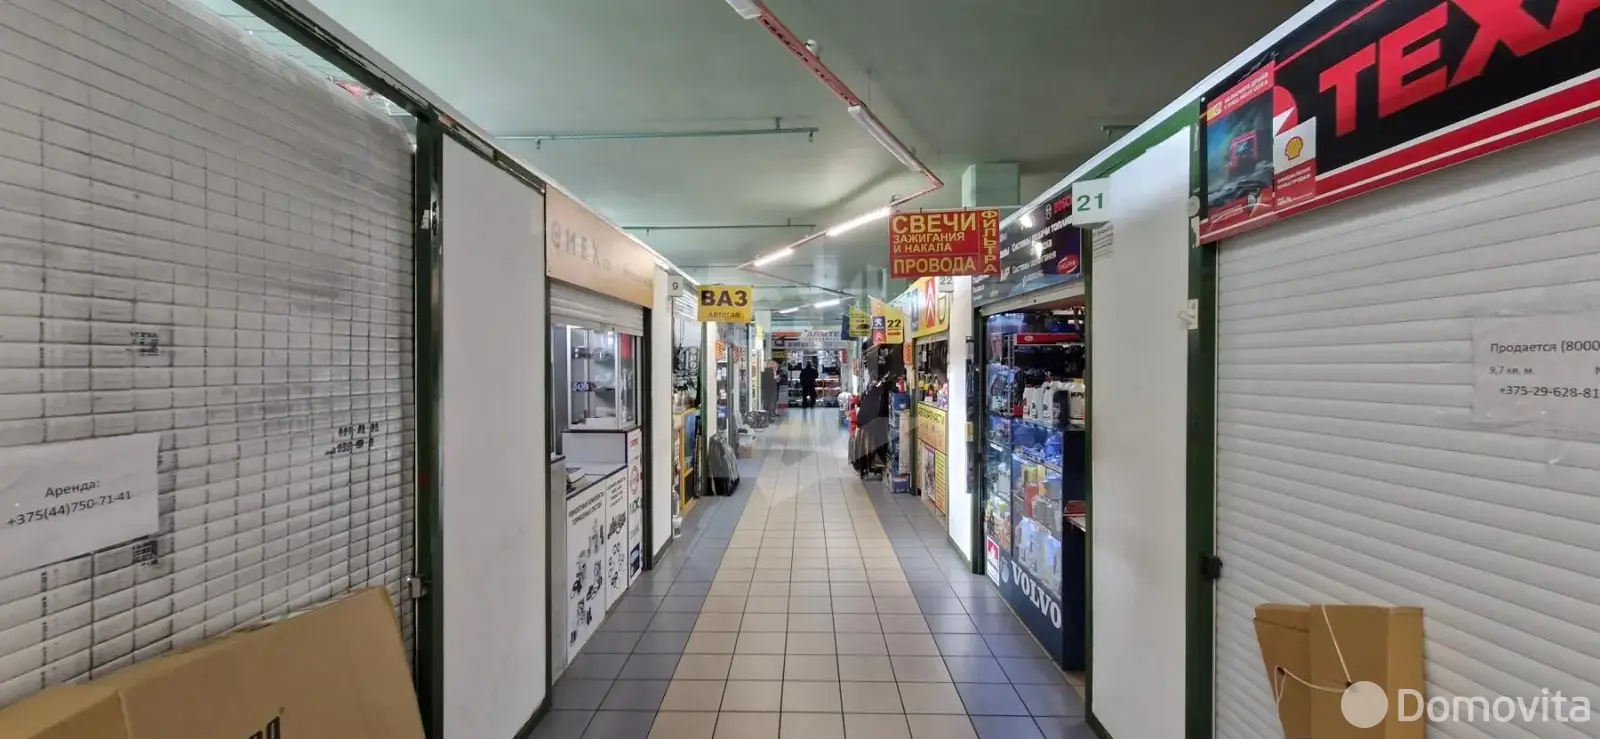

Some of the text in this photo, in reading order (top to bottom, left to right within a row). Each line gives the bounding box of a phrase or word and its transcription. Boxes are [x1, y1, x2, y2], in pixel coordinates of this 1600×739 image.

[1077, 193, 1104, 212] 21
[892, 213, 976, 234] СВЕЧИ
[893, 231, 965, 244] ЗАЖИГАНИЯ
[982, 210, 998, 273] ФИЛЬТРА
[894, 242, 952, 254] И НАКАЛА
[894, 257, 976, 275] ПРОВОДА
[672, 281, 679, 290] 9
[940, 276, 953, 285] 22
[701, 290, 748, 306] ВАЗ
[887, 319, 901, 328] 22
[1490, 342, 1556, 354] Продается
[45, 481, 100, 498] Аренда:
[7, 491, 131, 526] +375(44)750-71-41
[1011, 560, 1061, 629] VOLVO
